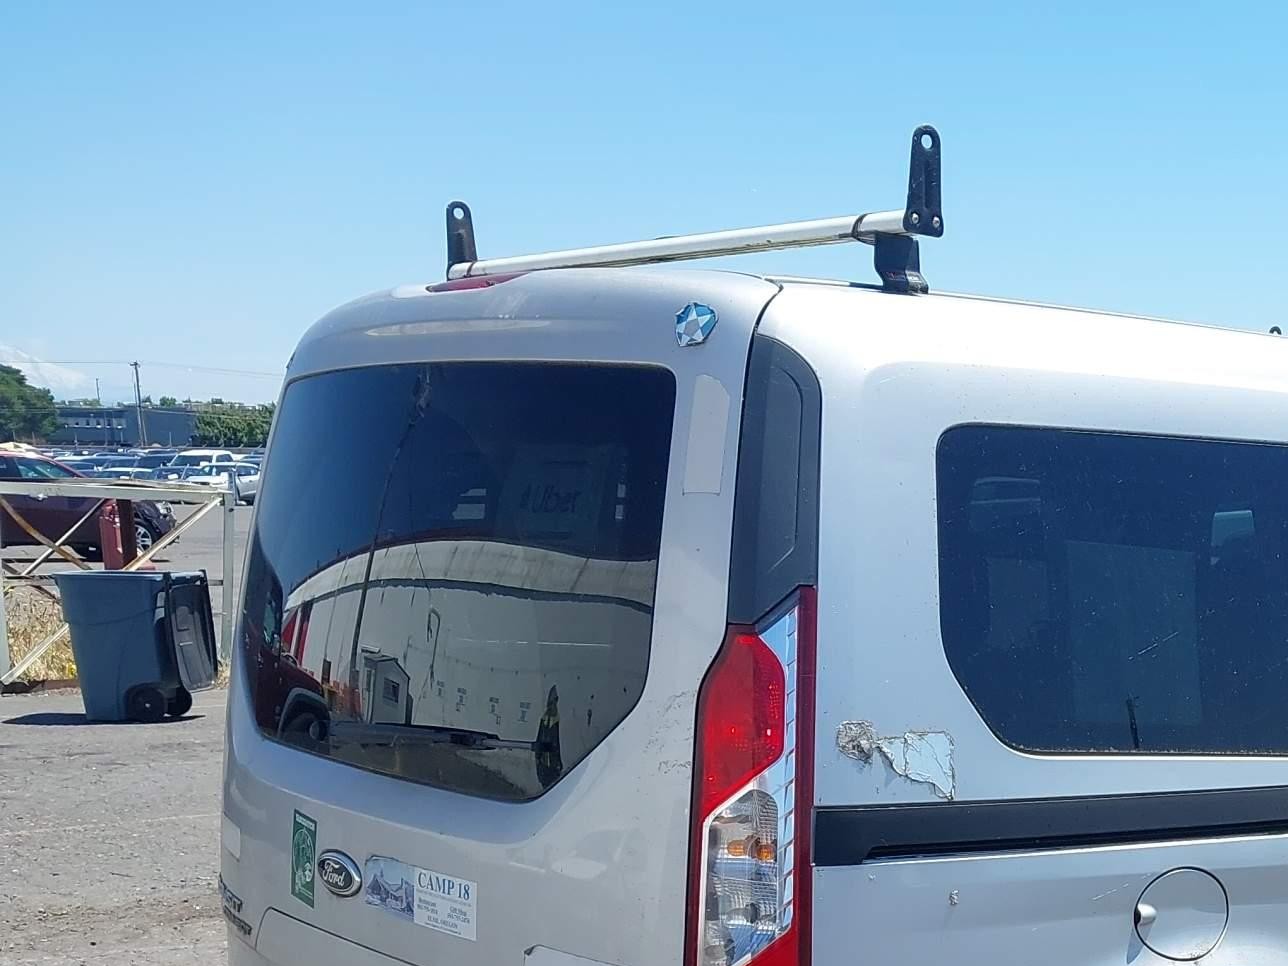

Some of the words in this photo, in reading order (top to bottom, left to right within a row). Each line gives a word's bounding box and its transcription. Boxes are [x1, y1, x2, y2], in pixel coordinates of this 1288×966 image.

[322, 860, 346, 887] Ford
[417, 871, 455, 896] CAMP
[458, 883, 470, 901] 18
